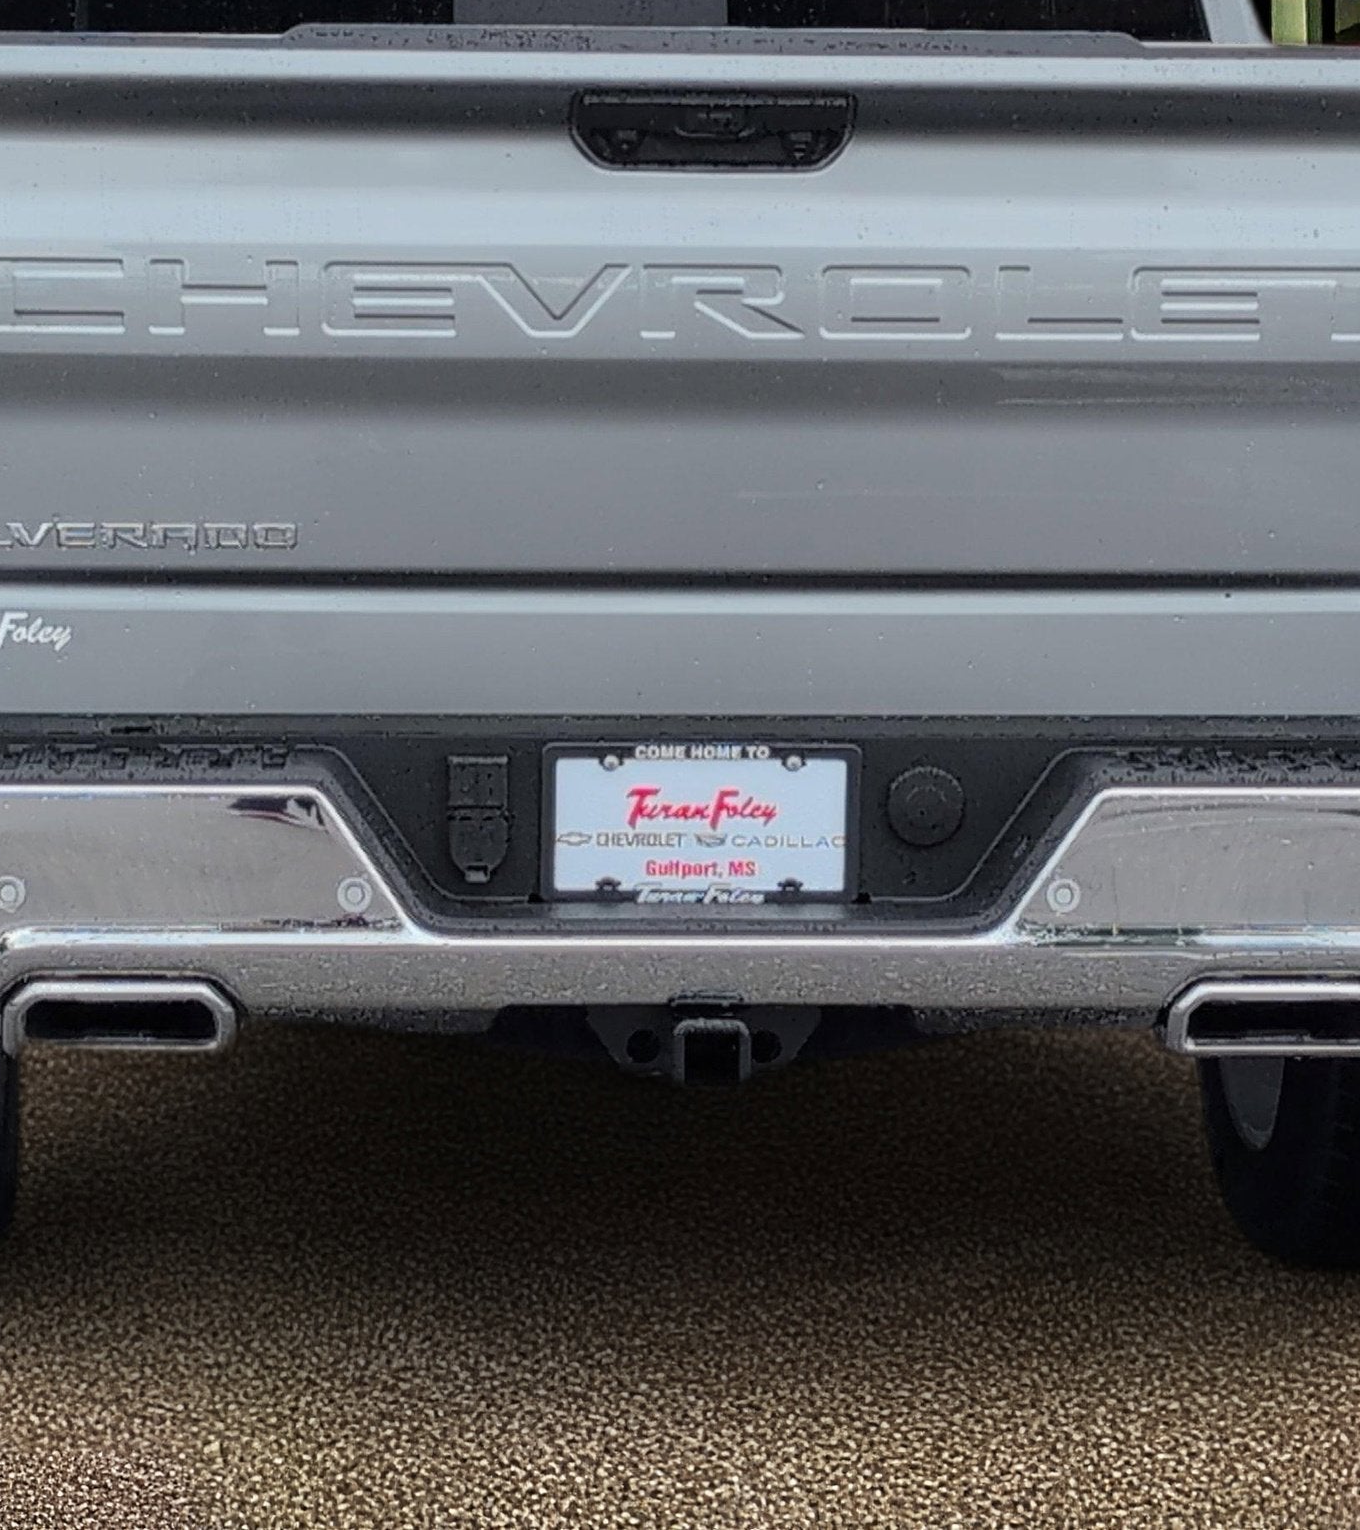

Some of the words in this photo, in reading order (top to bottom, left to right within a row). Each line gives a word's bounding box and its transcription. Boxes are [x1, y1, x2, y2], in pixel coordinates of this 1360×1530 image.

[635, 744, 686, 760] COME
[691, 744, 742, 760] HOME
[747, 744, 771, 760] TO
[596, 832, 685, 848] CHEVROLET
[731, 835, 846, 849] CADILLAC
[729, 861, 756, 877] MS
